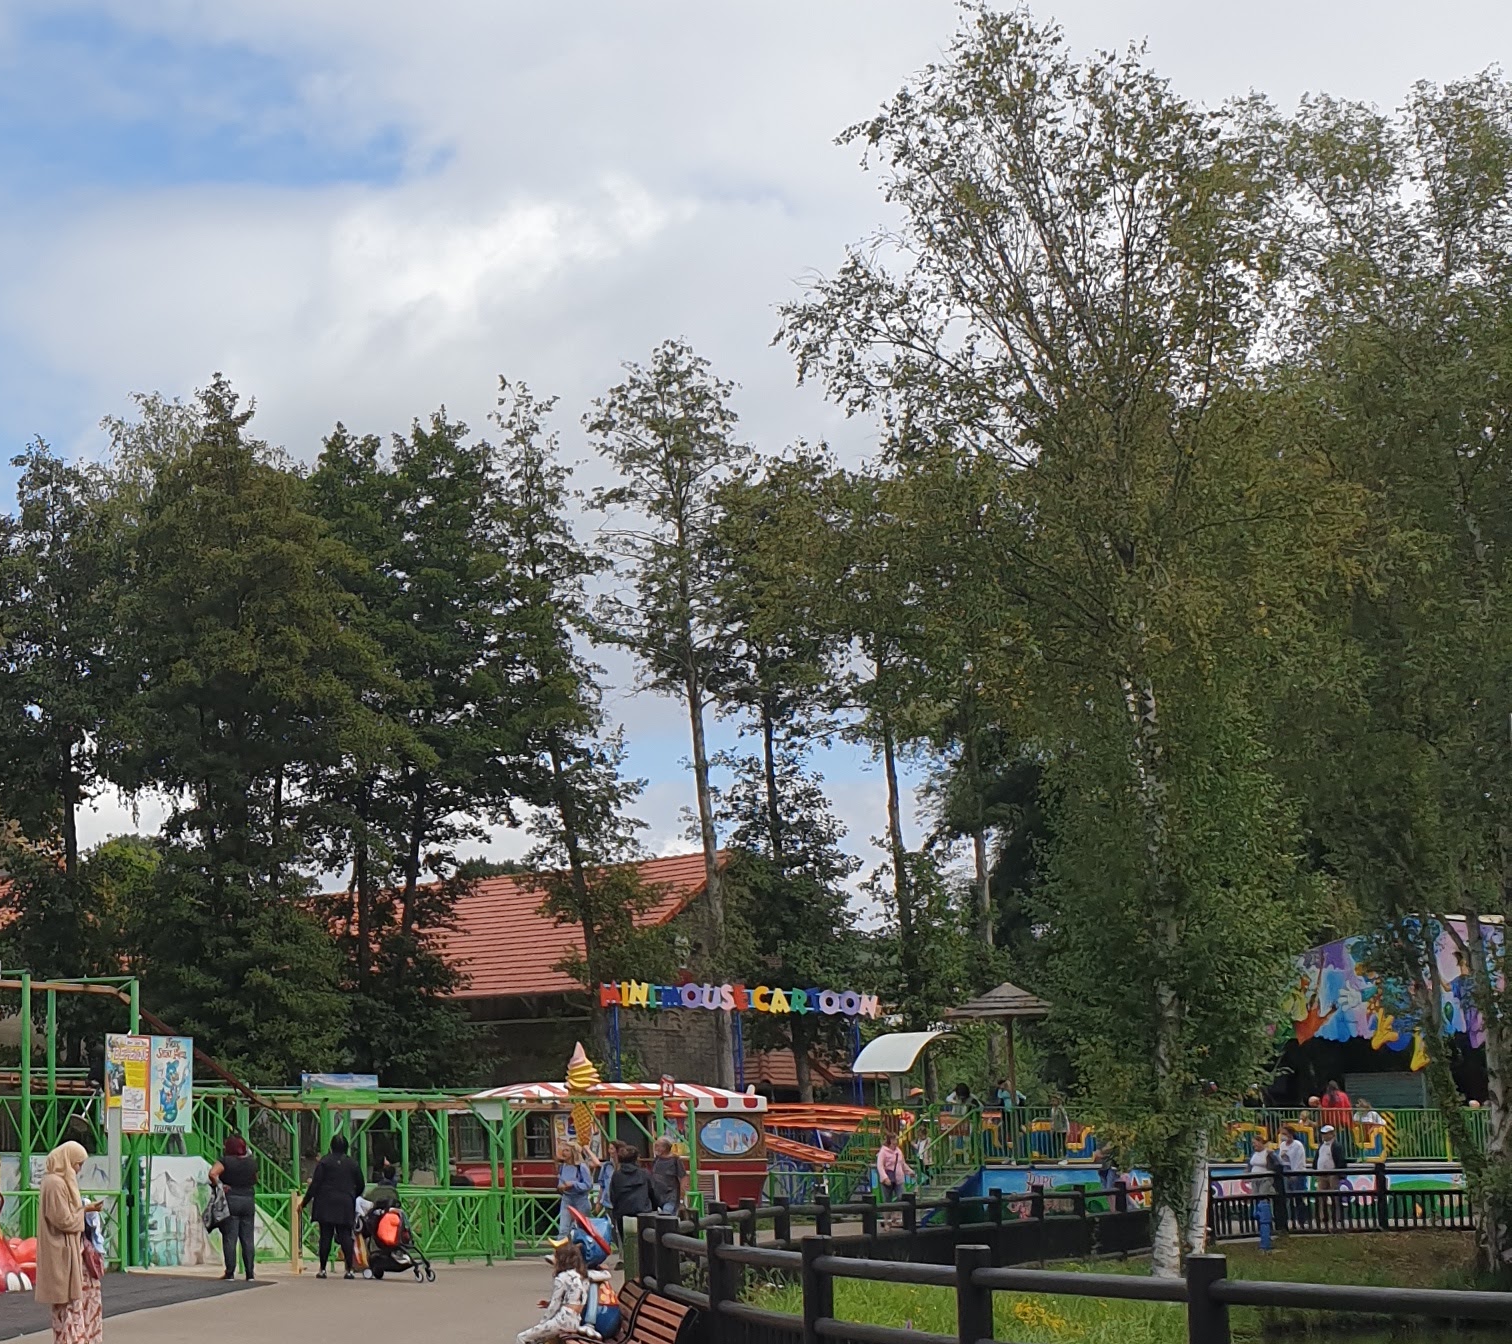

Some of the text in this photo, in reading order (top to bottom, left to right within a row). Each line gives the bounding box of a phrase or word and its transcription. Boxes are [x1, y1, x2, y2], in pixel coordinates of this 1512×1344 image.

[599, 978, 879, 1019] MINI MOUSE CARTOON
